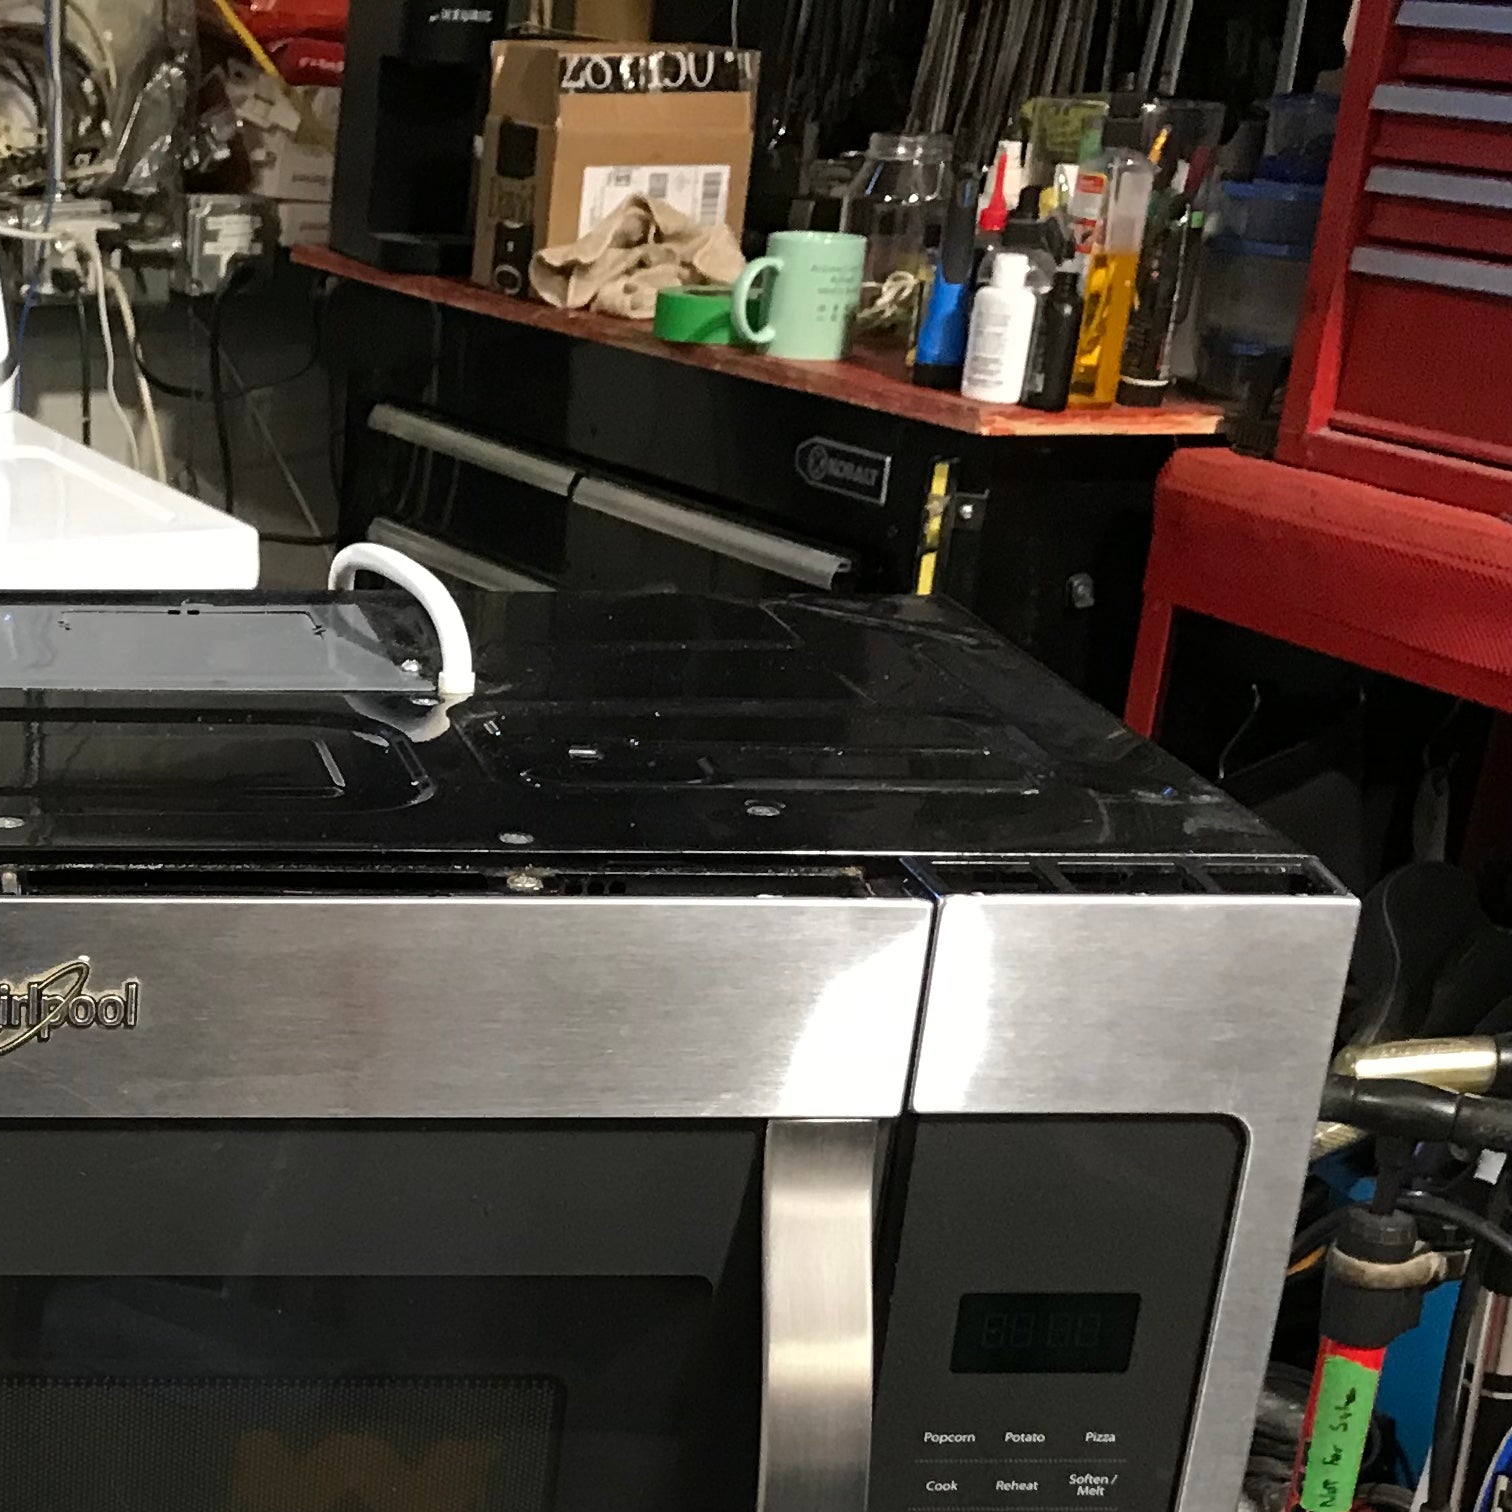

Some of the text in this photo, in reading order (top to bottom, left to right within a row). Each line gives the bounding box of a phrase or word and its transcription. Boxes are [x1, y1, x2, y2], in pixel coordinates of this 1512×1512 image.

[924, 1432, 975, 1444] Popcorn
[1005, 1432, 1045, 1442] Potato
[1085, 1432, 1115, 1442] Pizza
[926, 1480, 957, 1491] Cook
[996, 1480, 1038, 1491] Reheat
[1069, 1473, 1109, 1487] Soften
[1077, 1485, 1105, 1496] Melt
